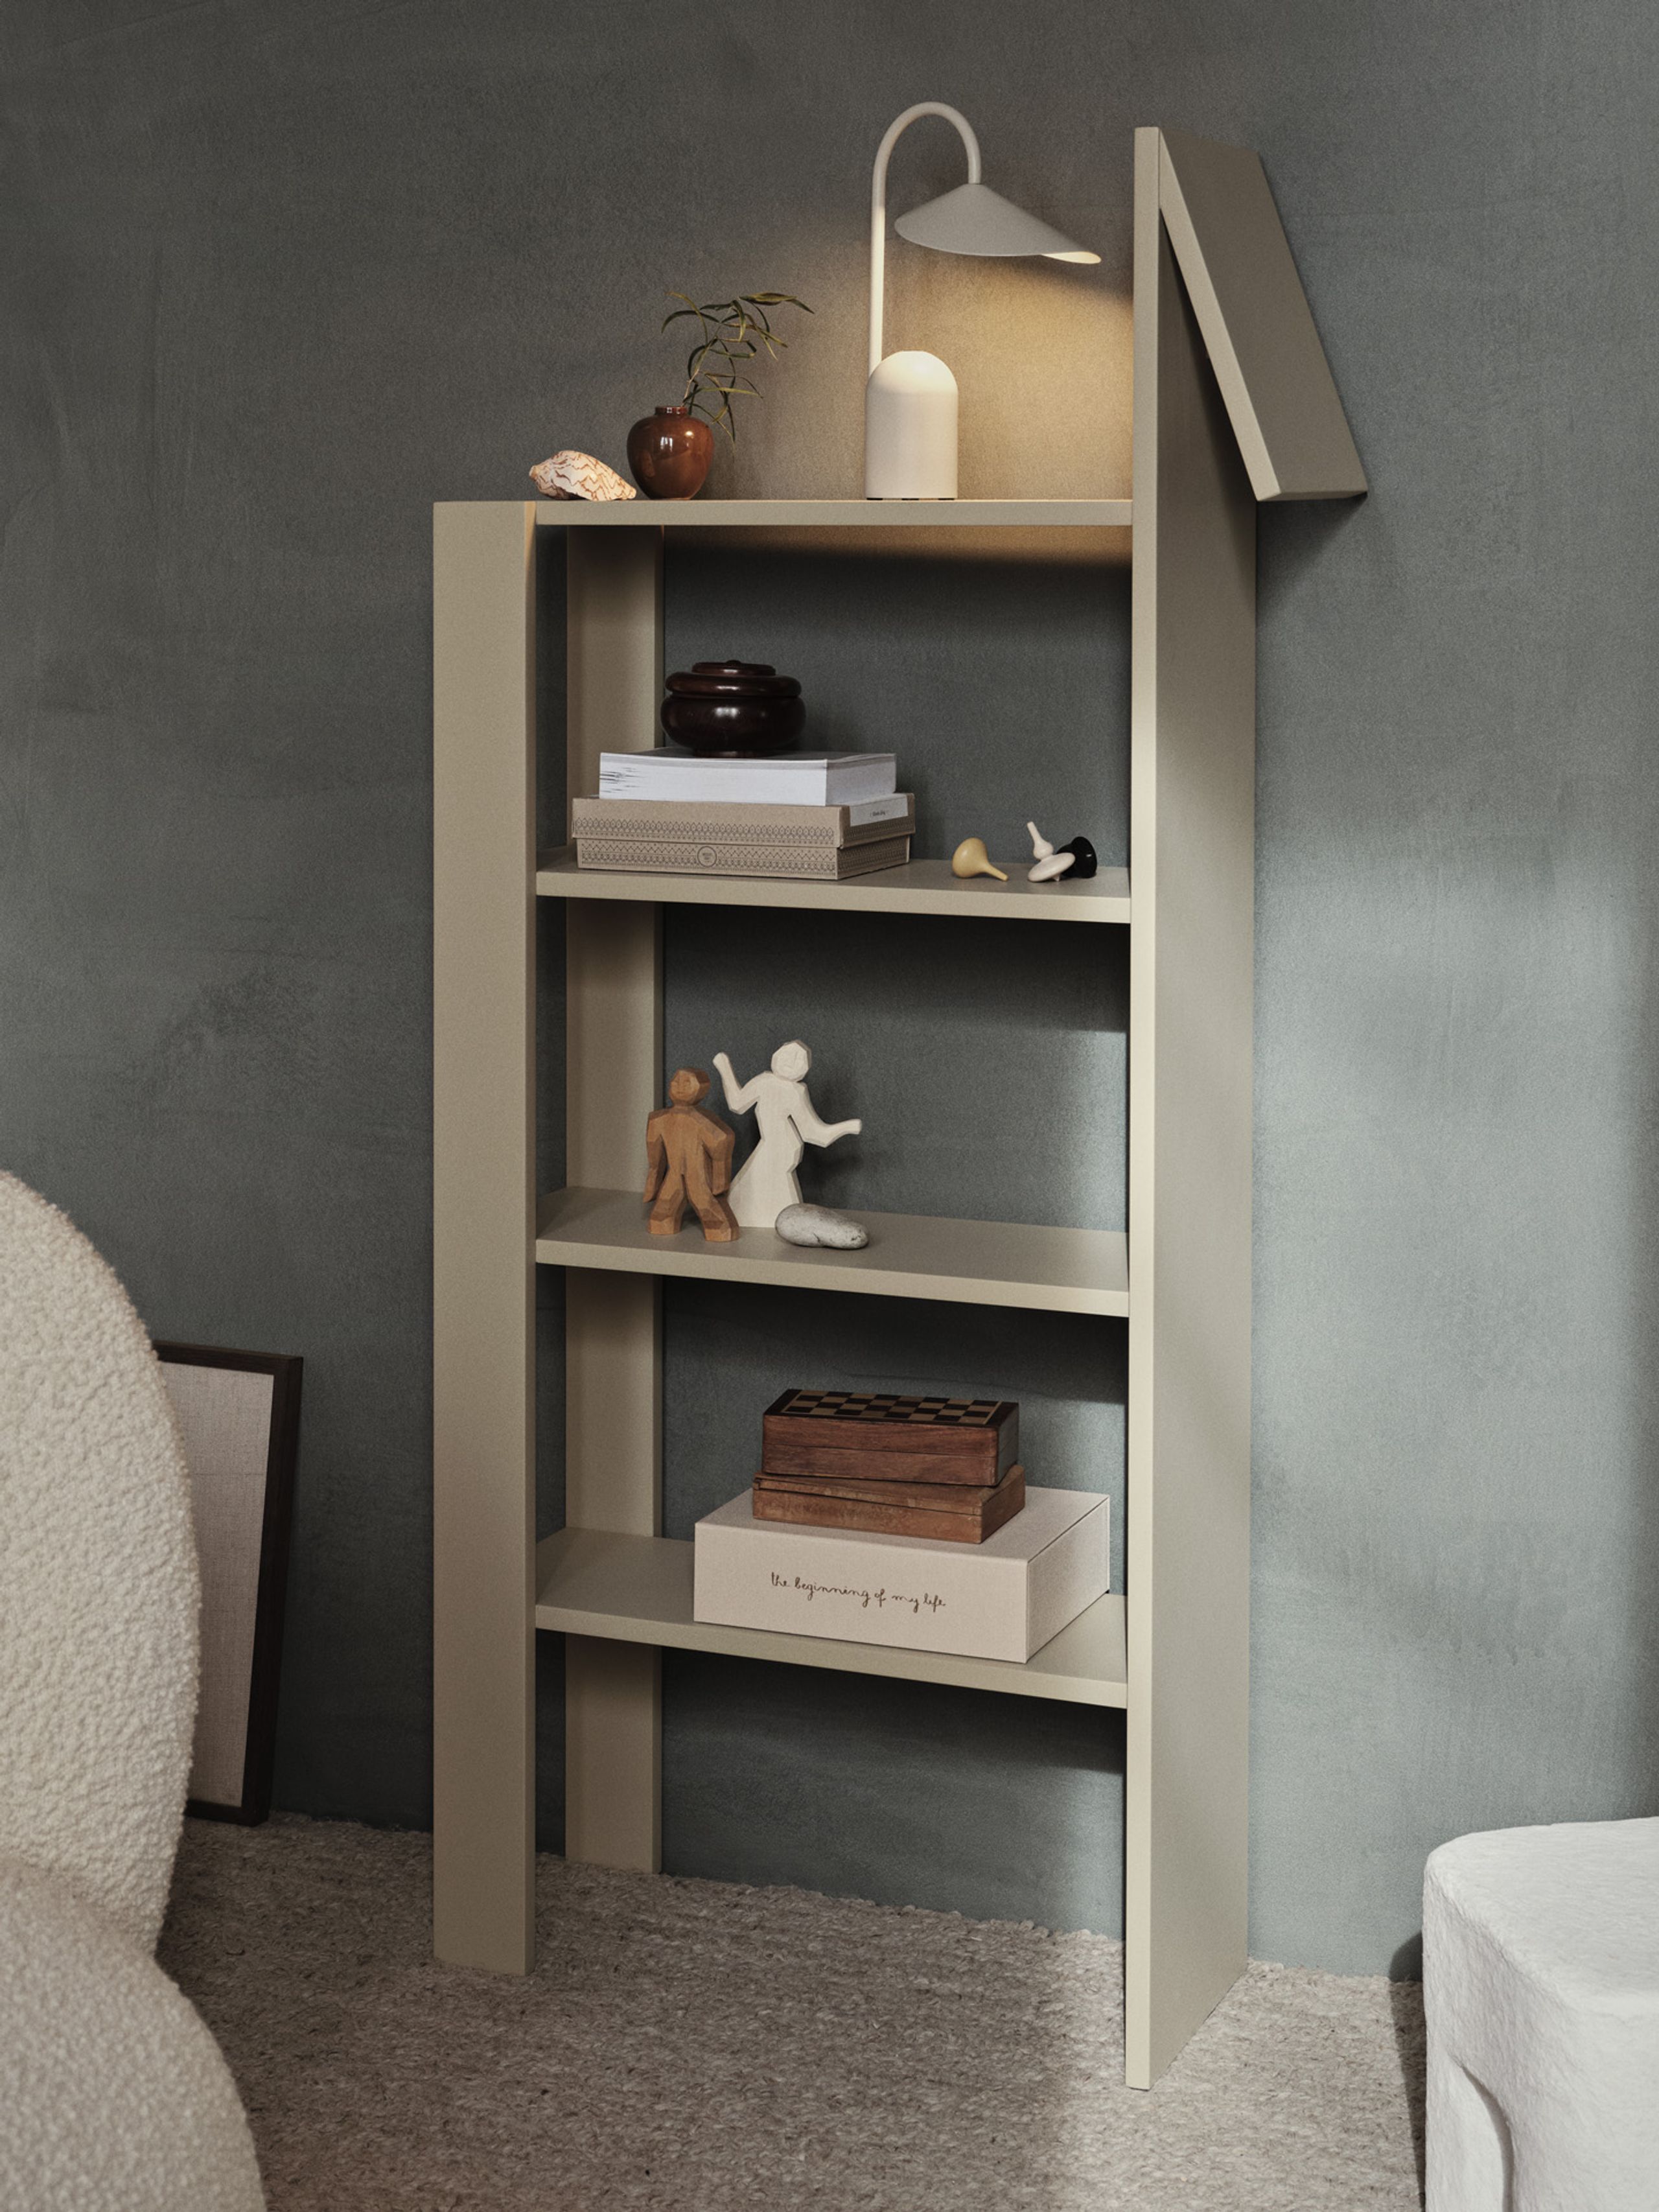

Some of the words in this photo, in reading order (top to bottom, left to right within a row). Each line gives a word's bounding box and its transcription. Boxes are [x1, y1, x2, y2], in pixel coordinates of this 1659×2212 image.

[771, 1571, 789, 1587] the
[795, 1576, 871, 1608] beginning
[874, 1588, 887, 1608] of
[891, 1595, 920, 1614] my
